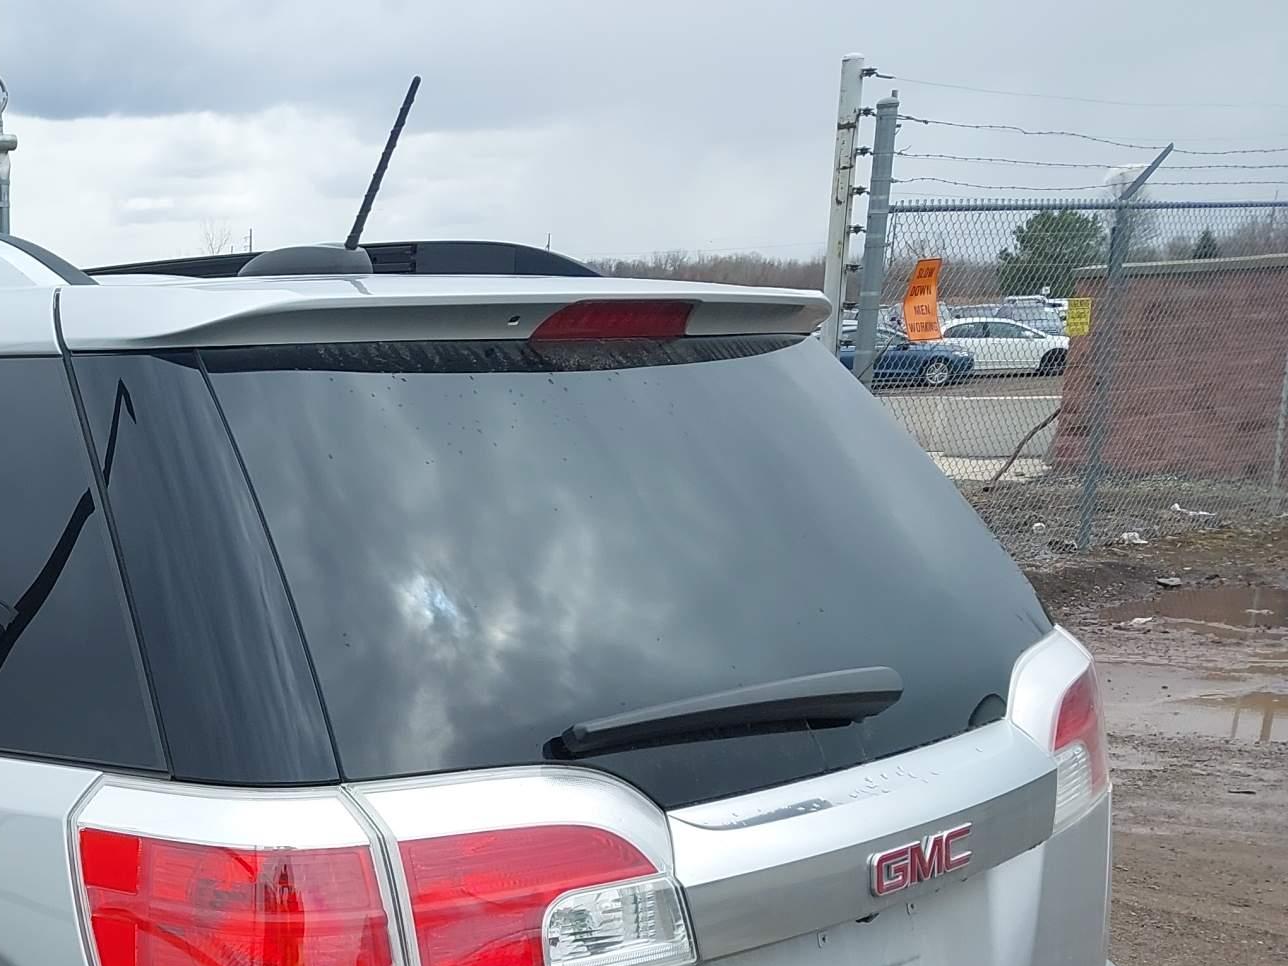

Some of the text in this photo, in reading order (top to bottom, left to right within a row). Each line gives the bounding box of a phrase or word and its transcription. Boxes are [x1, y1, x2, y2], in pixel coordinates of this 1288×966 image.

[916, 267, 936, 280] SLOW
[909, 285, 932, 297] DOWN
[913, 304, 931, 316] MEN
[867, 822, 972, 897] GMC
